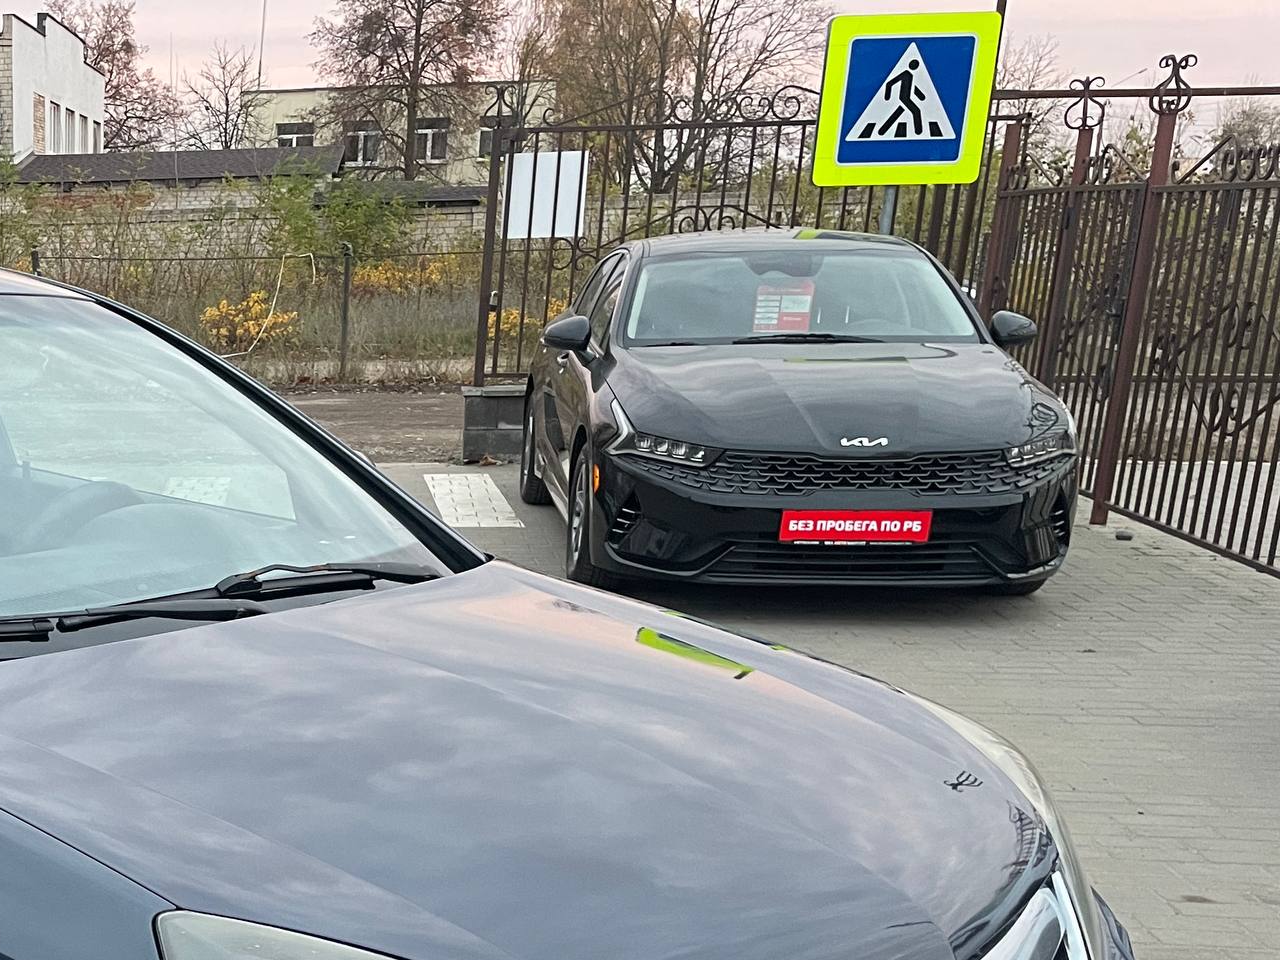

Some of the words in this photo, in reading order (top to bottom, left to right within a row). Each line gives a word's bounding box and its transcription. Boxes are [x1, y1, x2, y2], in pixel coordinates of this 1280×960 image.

[788, 520, 814, 532] БЕЗ
[816, 520, 878, 532] ПРОБЕГА
[880, 521, 901, 532] ПО
[903, 521, 922, 533] РБ
